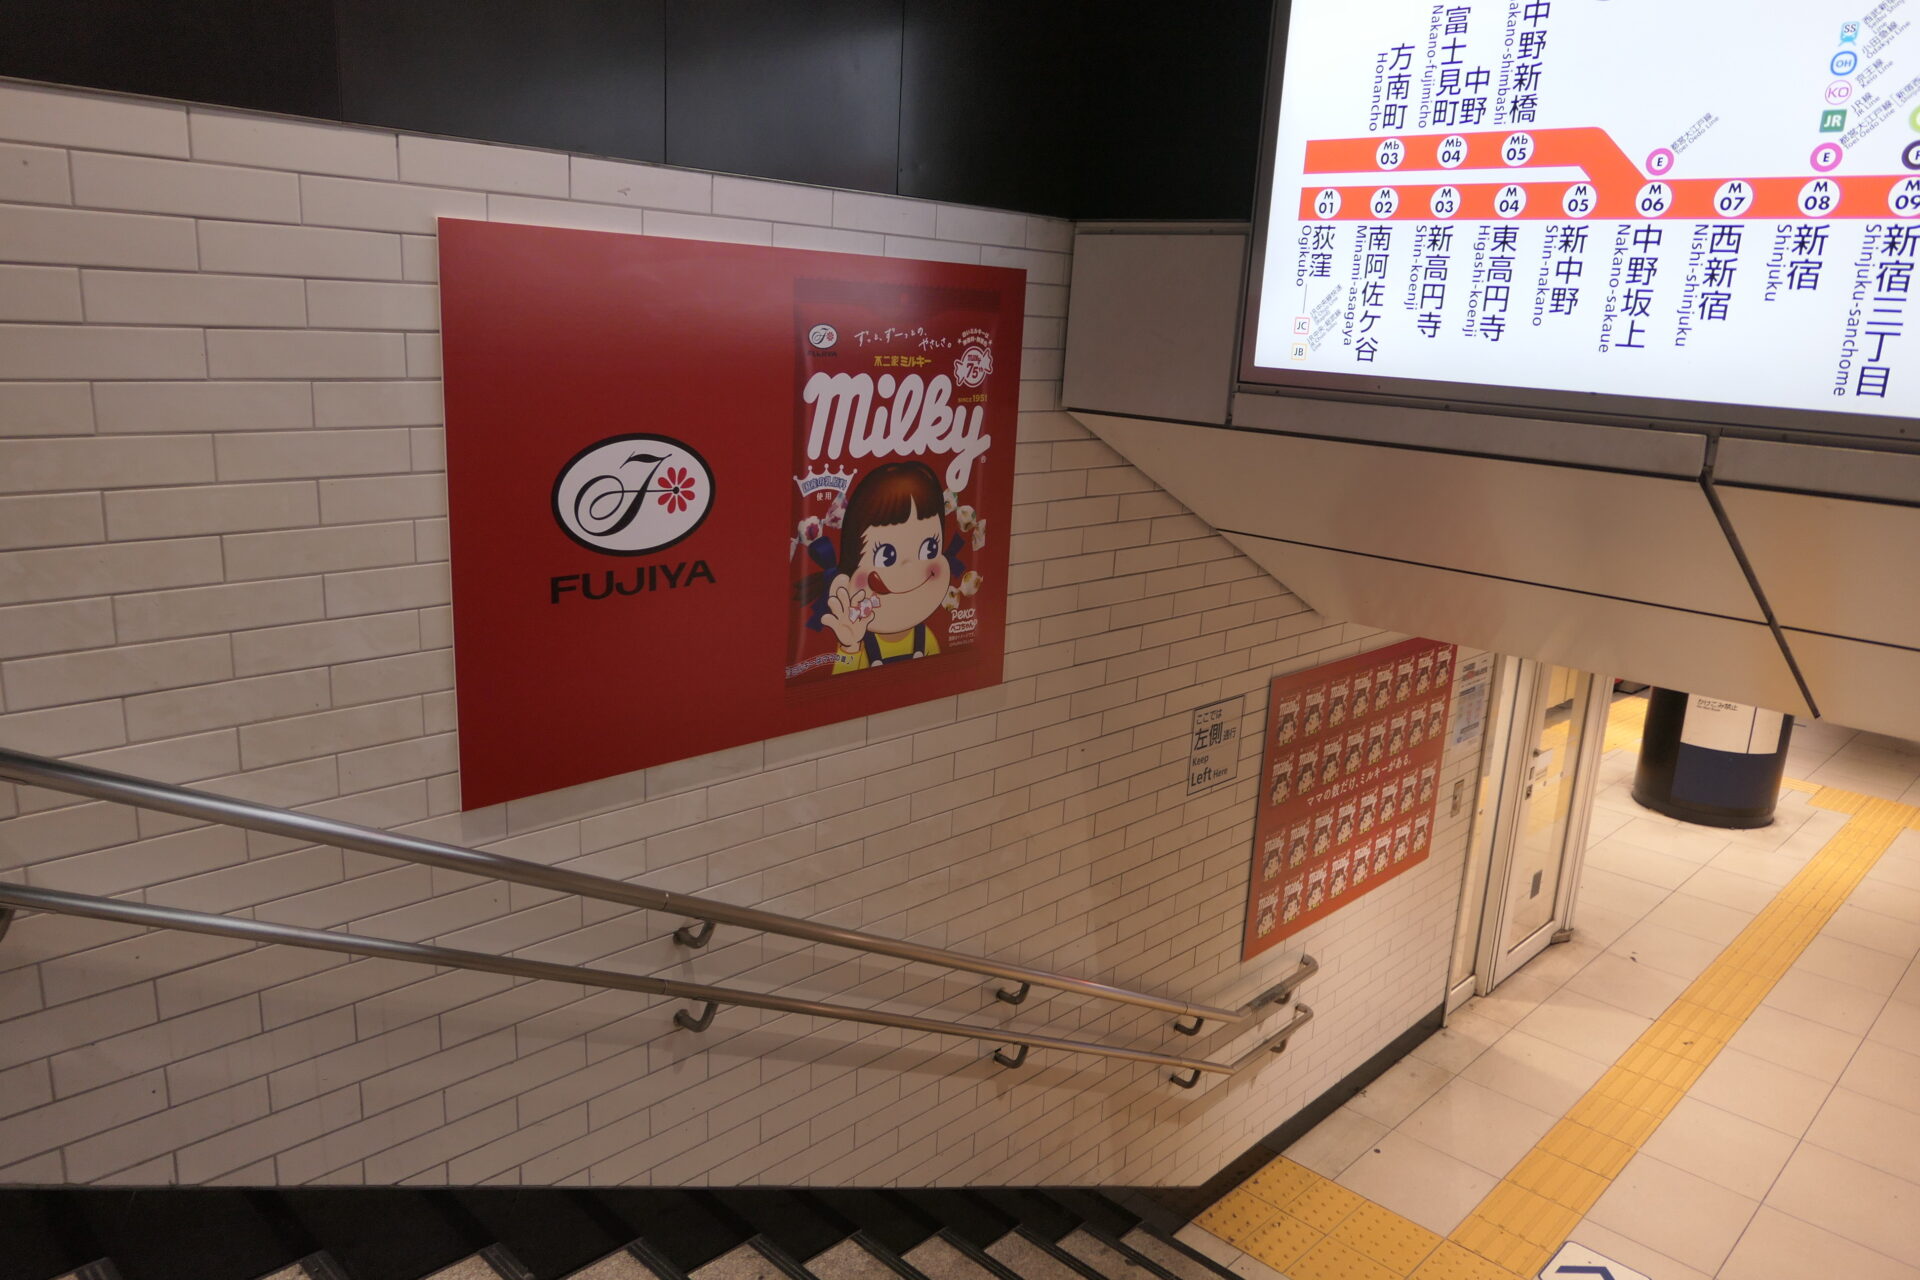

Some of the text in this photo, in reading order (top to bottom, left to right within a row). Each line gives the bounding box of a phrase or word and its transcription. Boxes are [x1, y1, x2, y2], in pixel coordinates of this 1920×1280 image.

[1844, 24, 1856, 33] SS
[1418, 5, 1444, 128] Nakano-fujimicho
[1432, 6, 1490, 126] 中野 富士見町
[1494, 0, 1521, 125] akano-shimbashi
[1509, 0, 1551, 123] 中野新橋
[1836, 59, 1852, 68] OH
[1369, 53, 1387, 131] Honancho
[1383, 43, 1415, 129] 方南町
[1827, 87, 1849, 98] KO
[1823, 115, 1842, 127] JR
[1383, 140, 1400, 150] Mb
[1444, 138, 1462, 148] Mb
[1510, 135, 1528, 145] Mb
[1380, 153, 1399, 165] 03
[1441, 150, 1461, 162] 04
[1506, 147, 1526, 161] 05
[1823, 152, 1830, 162] E
[1657, 157, 1663, 166] E
[1506, 187, 1517, 197] M
[1575, 185, 1587, 196] M
[1649, 184, 1662, 194] M
[1728, 182, 1742, 193] M
[1813, 181, 1828, 192] M
[1905, 180, 1920, 191] M
[1324, 189, 1334, 199] M
[1380, 189, 1390, 199] M
[1441, 188, 1452, 198] M
[1318, 202, 1334, 214] 01
[1374, 201, 1393, 214] 02
[1435, 201, 1454, 213] 03
[1499, 200, 1519, 212] 04
[1567, 199, 1589, 212] 05
[1641, 198, 1664, 211] 06
[1720, 197, 1745, 211] 07
[1804, 196, 1830, 210] 08
[1296, 225, 1311, 286] Ogikubo
[1309, 225, 1336, 277] 荻窪
[1787, 224, 1830, 290] 新宿
[1404, 225, 1427, 310] Shin-koenji
[1765, 224, 1792, 301] Shinjuku
[1532, 225, 1558, 326] Shin-nakano
[1549, 225, 1589, 315] 新中野
[1699, 224, 1744, 321] 西新宿
[1343, 225, 1367, 346] Minami-asagaya
[1417, 225, 1454, 338] 新高円寺
[1462, 225, 1491, 337] Higashi-koenji
[1480, 225, 1519, 341] 東高円寺
[1615, 224, 1662, 348] 中野坂上
[1675, 224, 1709, 346] Nishi-shinjuku
[1598, 224, 1631, 353] Nakano-sakaue
[1833, 224, 1882, 397] Shinjuku-sanchome
[1856, 224, 1920, 398] 新宿三丁目
[1297, 321, 1307, 330] JC
[1294, 347, 1304, 356] JB
[874, 355, 932, 368] 不二家ミルキー
[816, 492, 832, 501] 使用
[551, 560, 716, 604] FUJIYA
[1196, 709, 1223, 725] ここでは
[1192, 755, 1209, 766] Keep
[1191, 767, 1228, 787] Left Here
